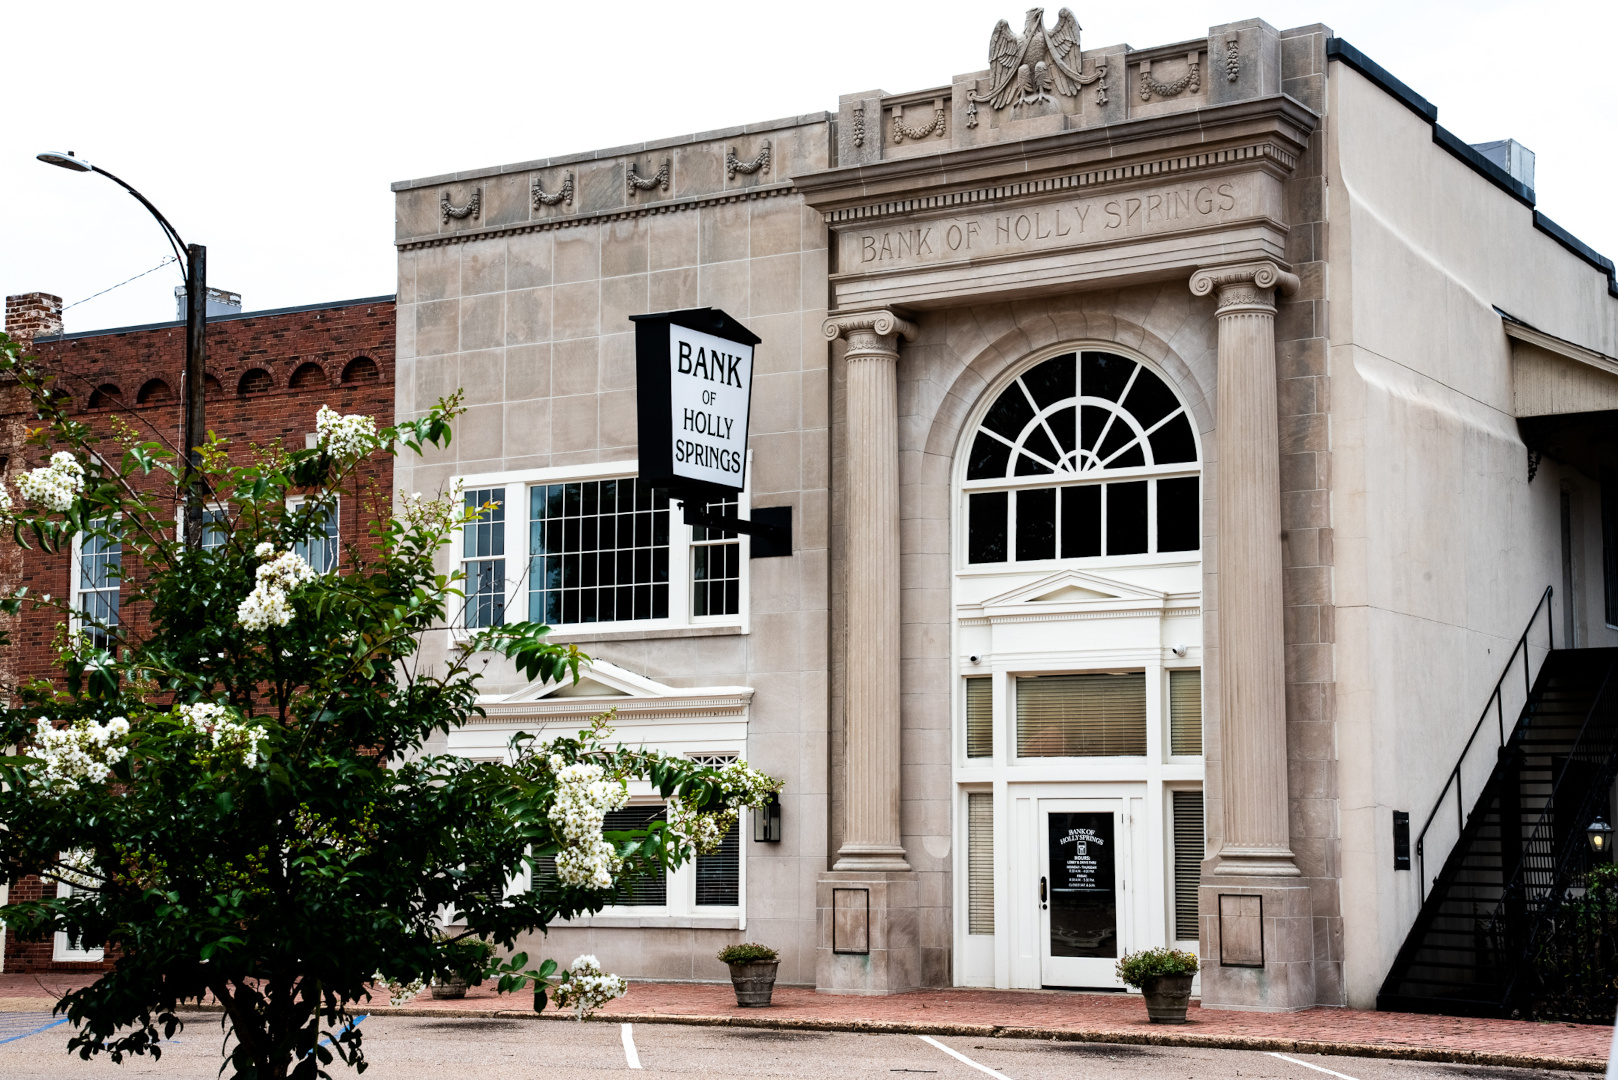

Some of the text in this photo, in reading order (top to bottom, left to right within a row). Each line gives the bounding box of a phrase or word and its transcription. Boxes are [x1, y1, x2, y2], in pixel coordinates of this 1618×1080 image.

[861, 182, 1235, 264] BANK OF HOLLY SPRINGS
[677, 340, 743, 389] BANK
[701, 389, 717, 406] OF
[683, 407, 734, 440] HOLLY
[675, 438, 741, 474] SPRINGS
[1060, 834, 1104, 846] HOLLY SPRINGS
[1068, 828, 1086, 836] BANK
